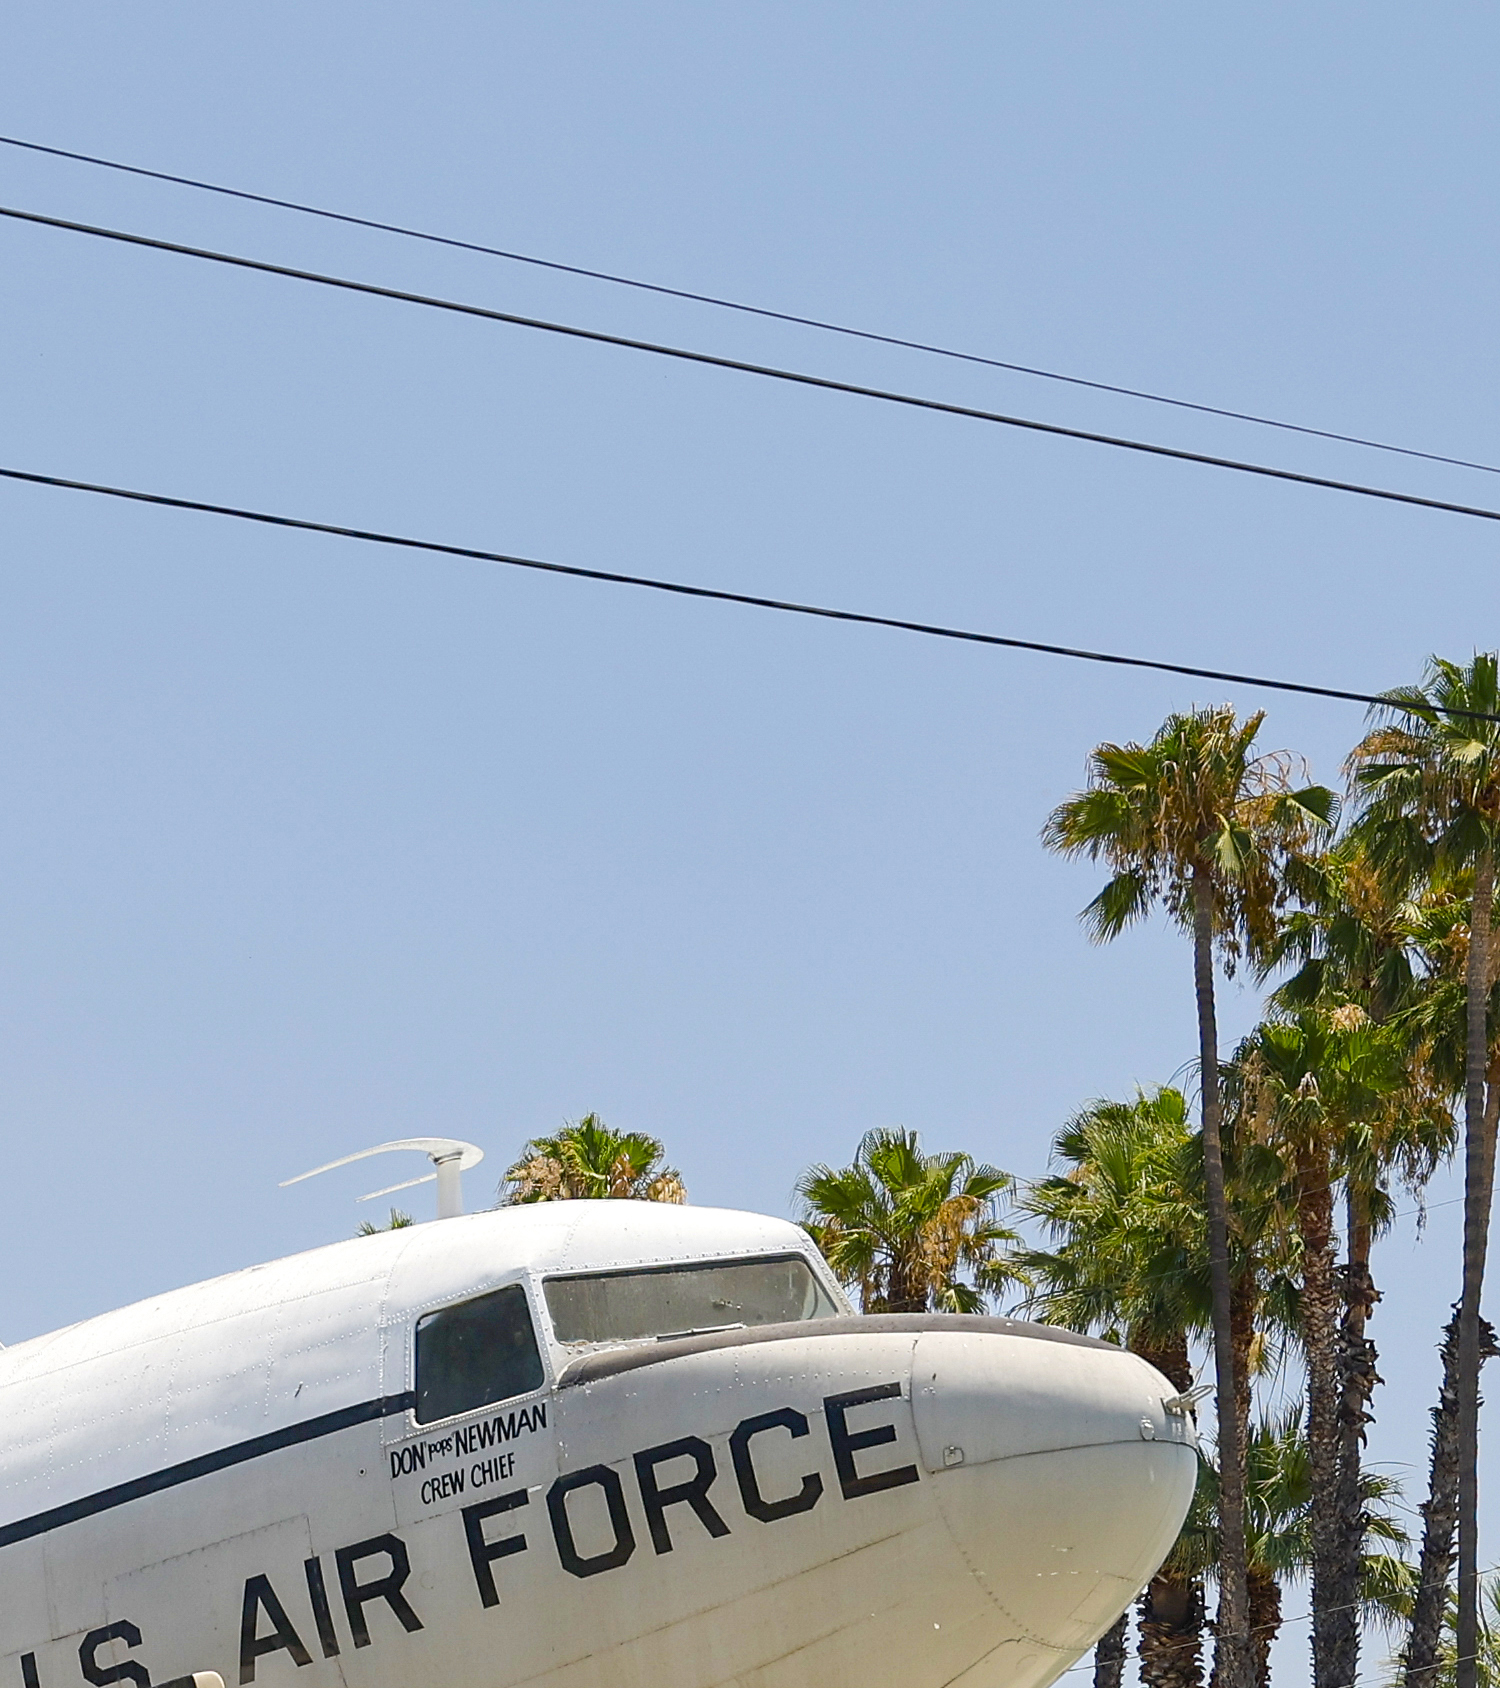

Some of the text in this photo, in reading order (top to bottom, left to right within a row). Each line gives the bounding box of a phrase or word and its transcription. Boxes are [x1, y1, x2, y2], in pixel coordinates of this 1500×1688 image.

[390, 1442, 426, 1479] DON
[454, 1403, 547, 1458] NEWMAN
[421, 1452, 516, 1505] CREW CHIEF
[239, 1533, 425, 1686] AIR
[459, 1382, 921, 1610] FORCE
